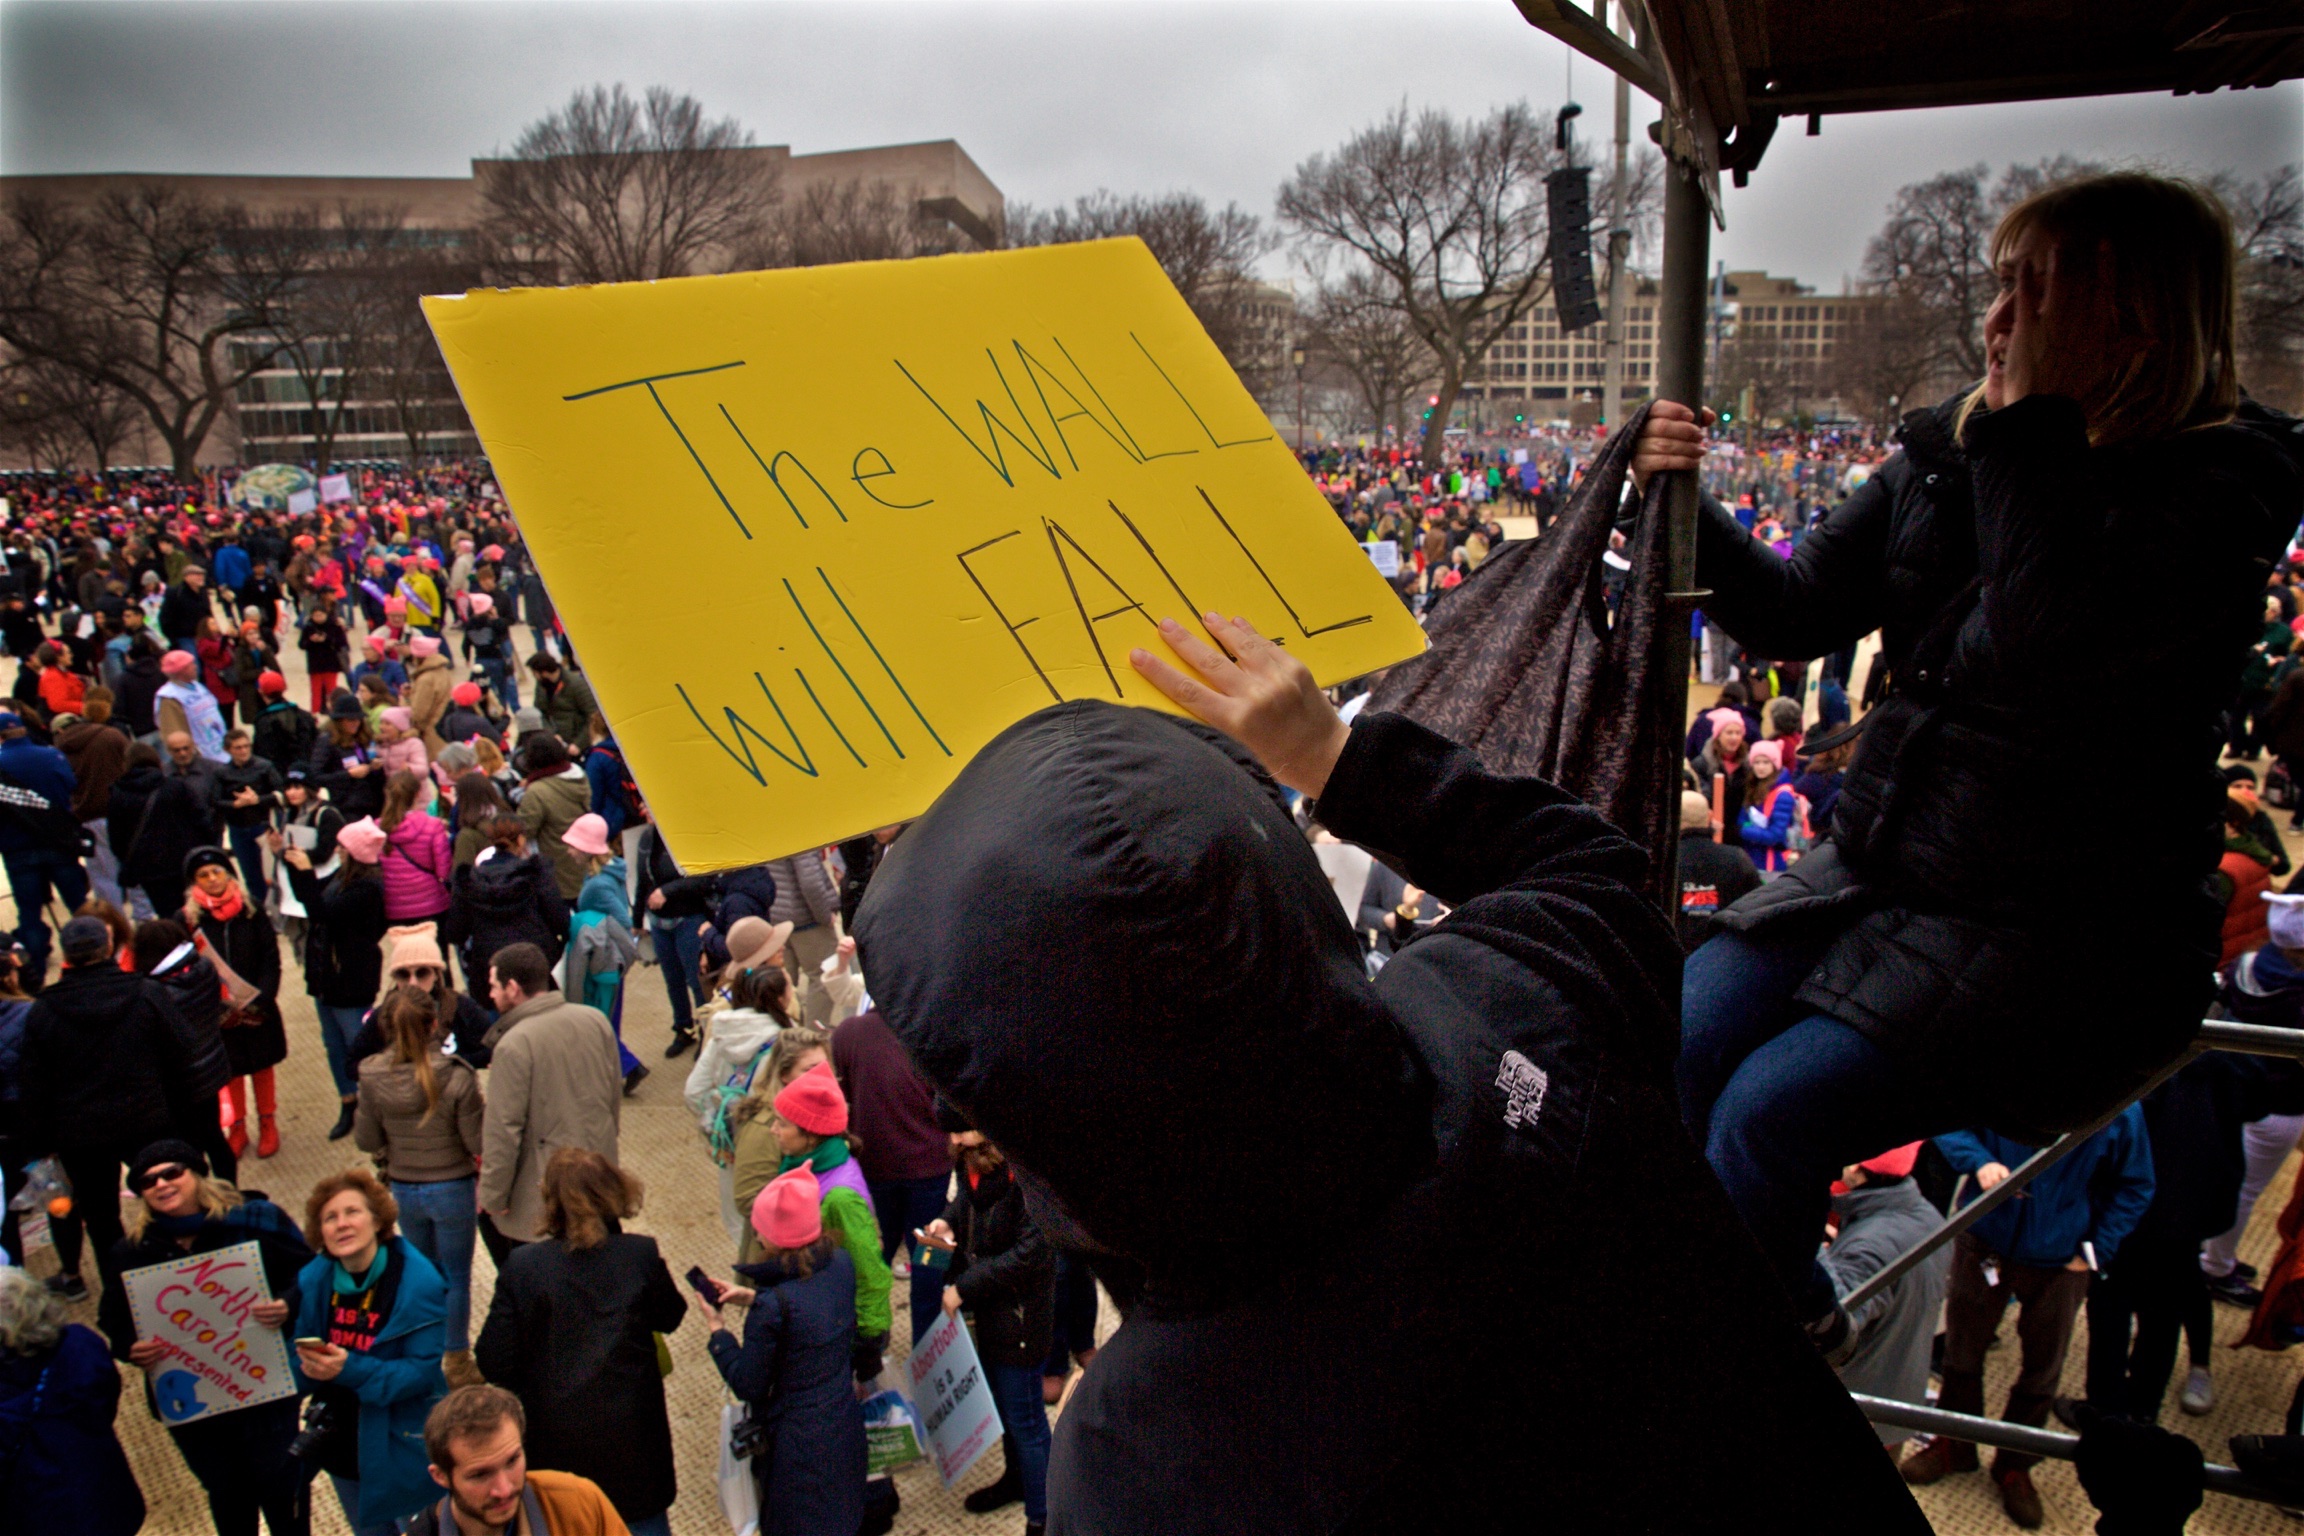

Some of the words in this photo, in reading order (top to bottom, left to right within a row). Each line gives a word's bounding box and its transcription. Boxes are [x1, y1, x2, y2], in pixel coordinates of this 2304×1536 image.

[562, 360, 935, 540] The
[893, 331, 1274, 488] WALL
[956, 485, 1374, 703] FALL
[1502, 1074, 1530, 1129] NORTH
[1522, 1079, 1545, 1125] FACE
[175, 1257, 259, 1329] North
[155, 1283, 267, 1385] Carolina
[910, 1320, 959, 1386] Abortion
